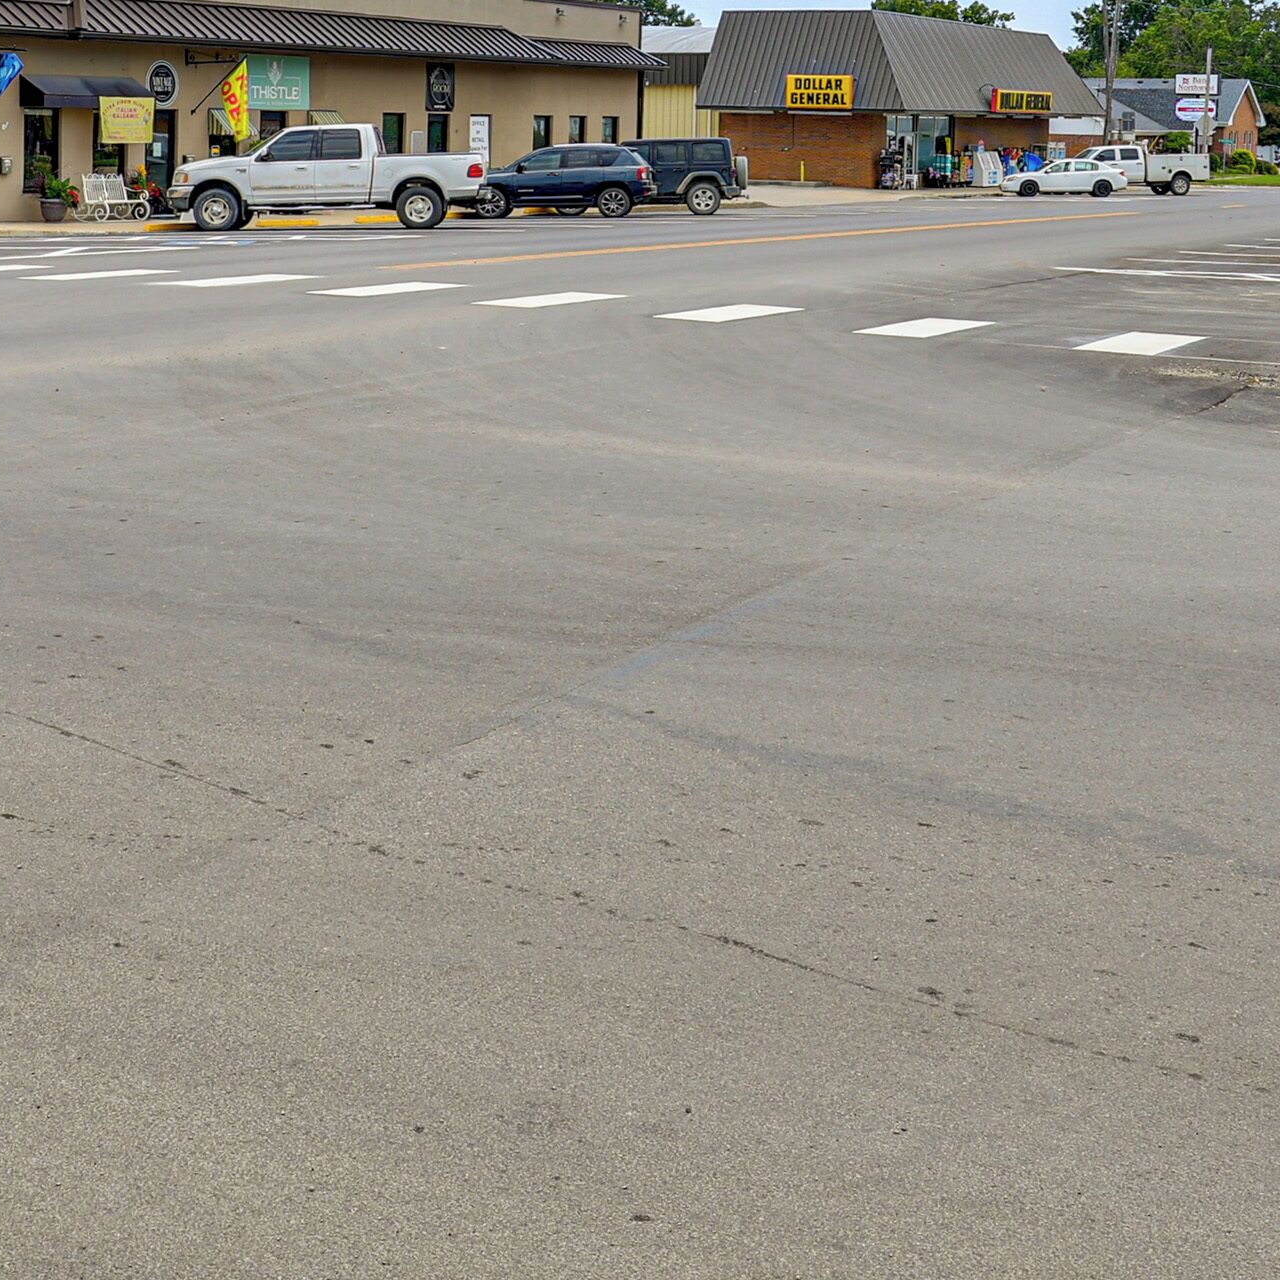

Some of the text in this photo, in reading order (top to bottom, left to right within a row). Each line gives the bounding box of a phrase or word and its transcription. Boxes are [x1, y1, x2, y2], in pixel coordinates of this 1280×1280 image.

[794, 78, 843, 91] DOLLAR
[251, 85, 299, 100] THISTLE
[791, 92, 847, 105] GENERAL
[1000, 92, 1051, 111] DOLLAR GENERAL
